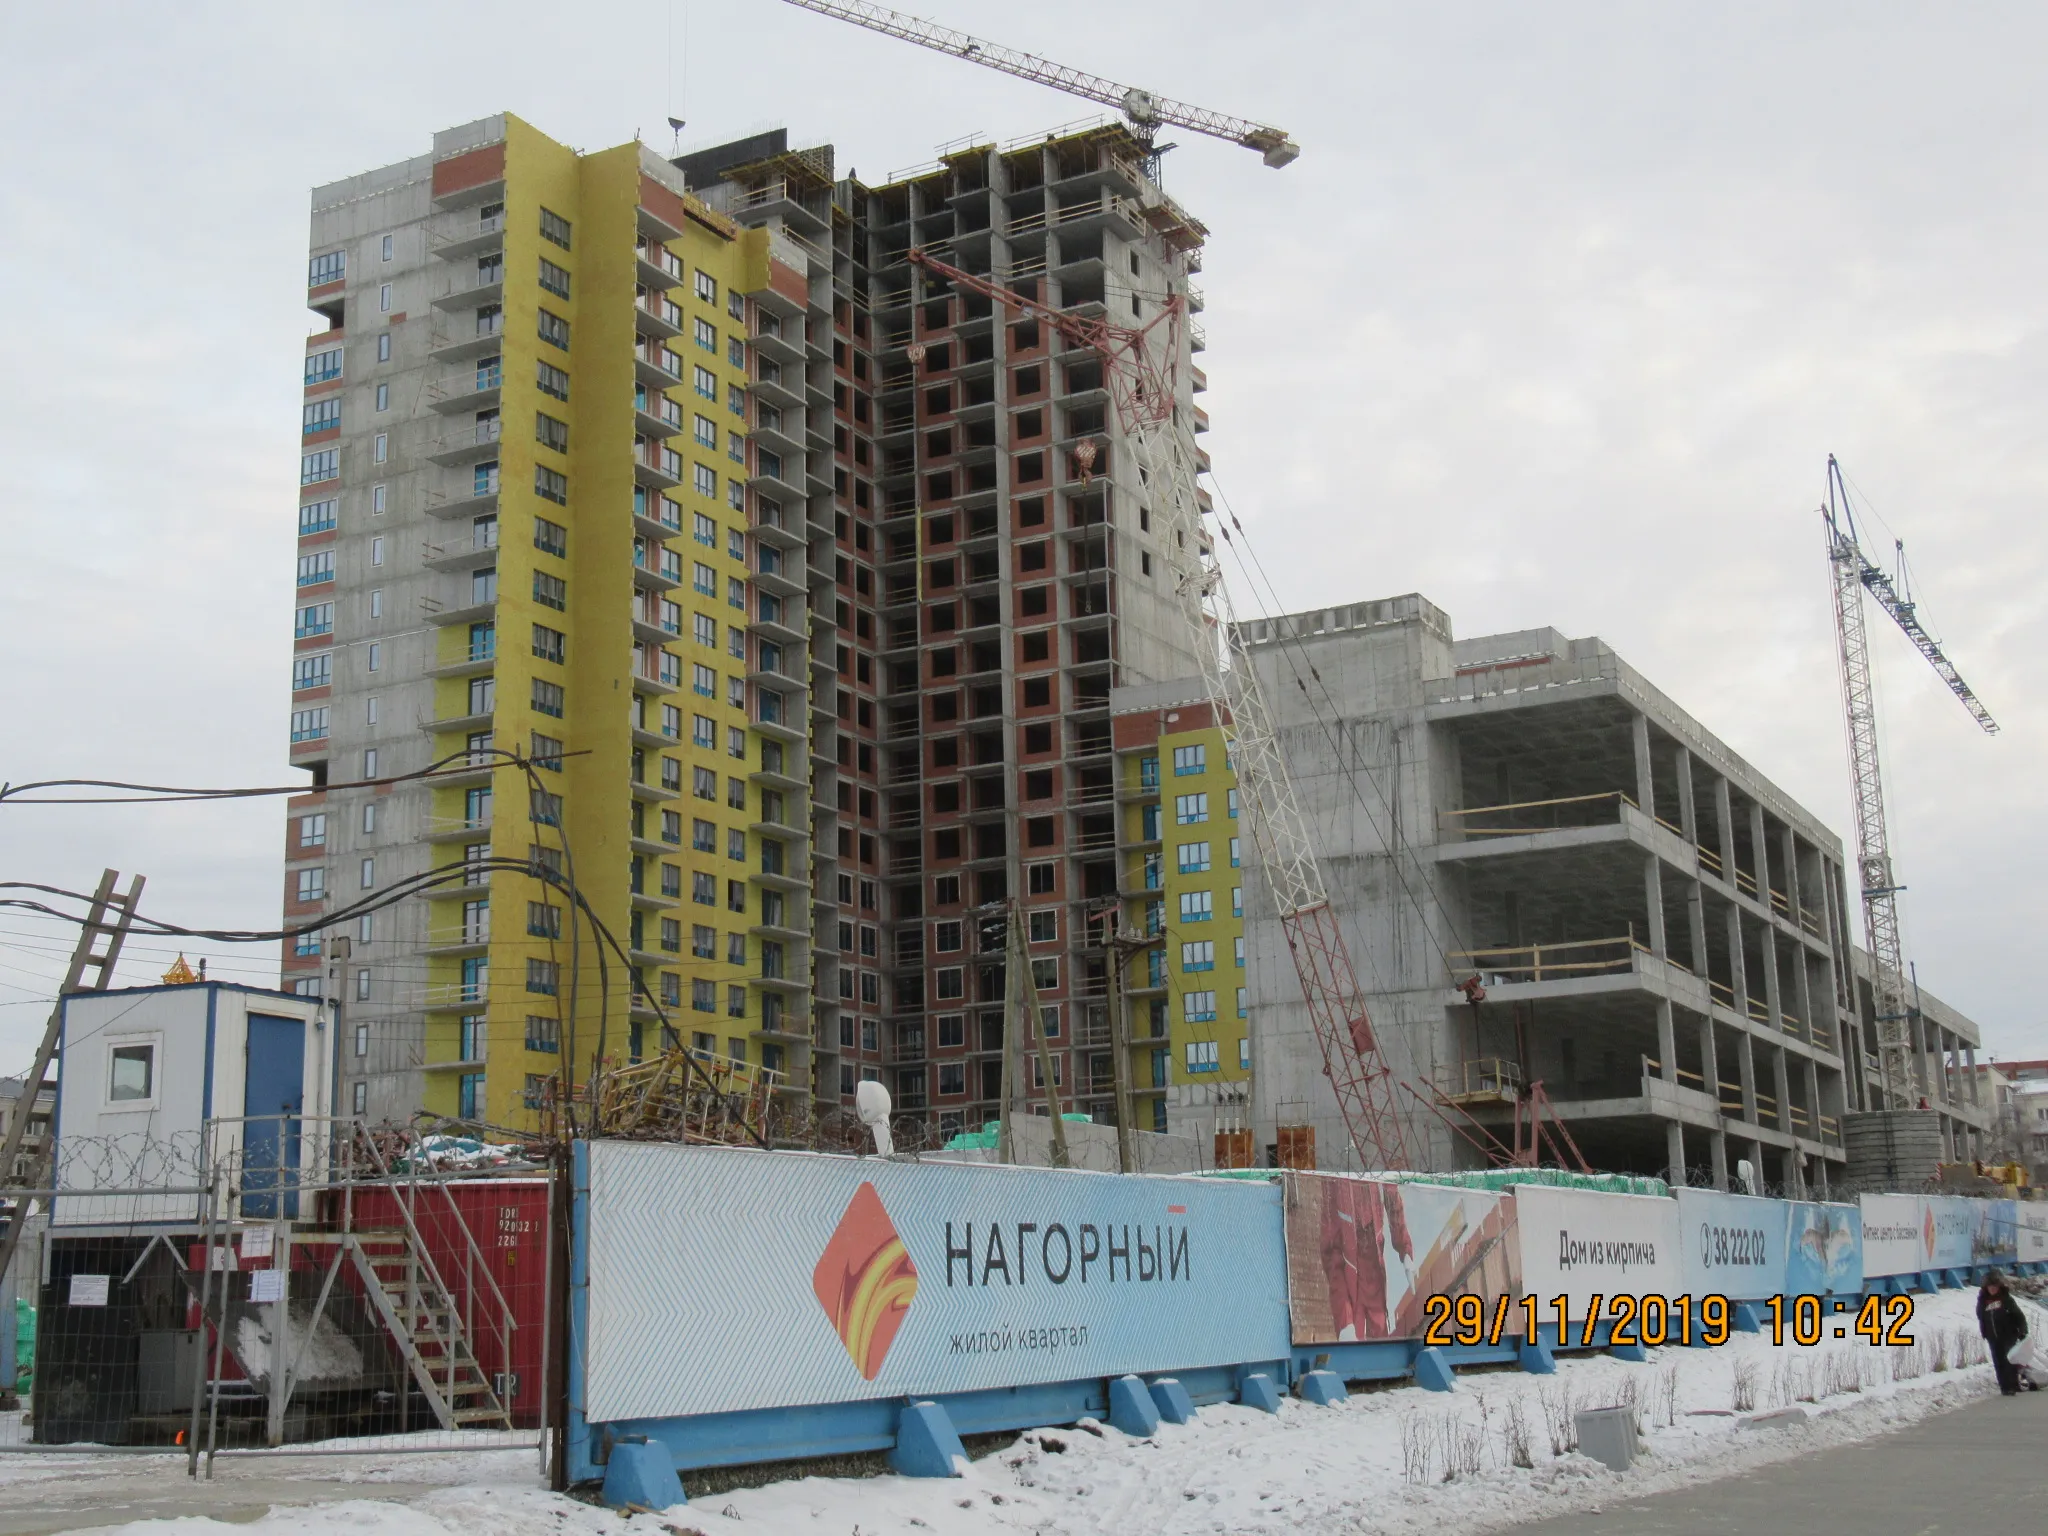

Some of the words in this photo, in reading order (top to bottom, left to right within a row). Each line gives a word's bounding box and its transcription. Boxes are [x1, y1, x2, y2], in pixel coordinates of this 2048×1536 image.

[945, 1205, 1191, 1287] НАГОРНЫЙ
[1559, 1229, 1587, 1271] Дом
[1589, 1240, 1604, 1265] из
[1605, 1240, 1656, 1274] кирпича
[1713, 1226, 1728, 1266] 38
[1730, 1228, 1750, 1266] 222
[1752, 1229, 1766, 1266] 02
[949, 1323, 1012, 1356] жилой
[1018, 1325, 1088, 1356] квартал
